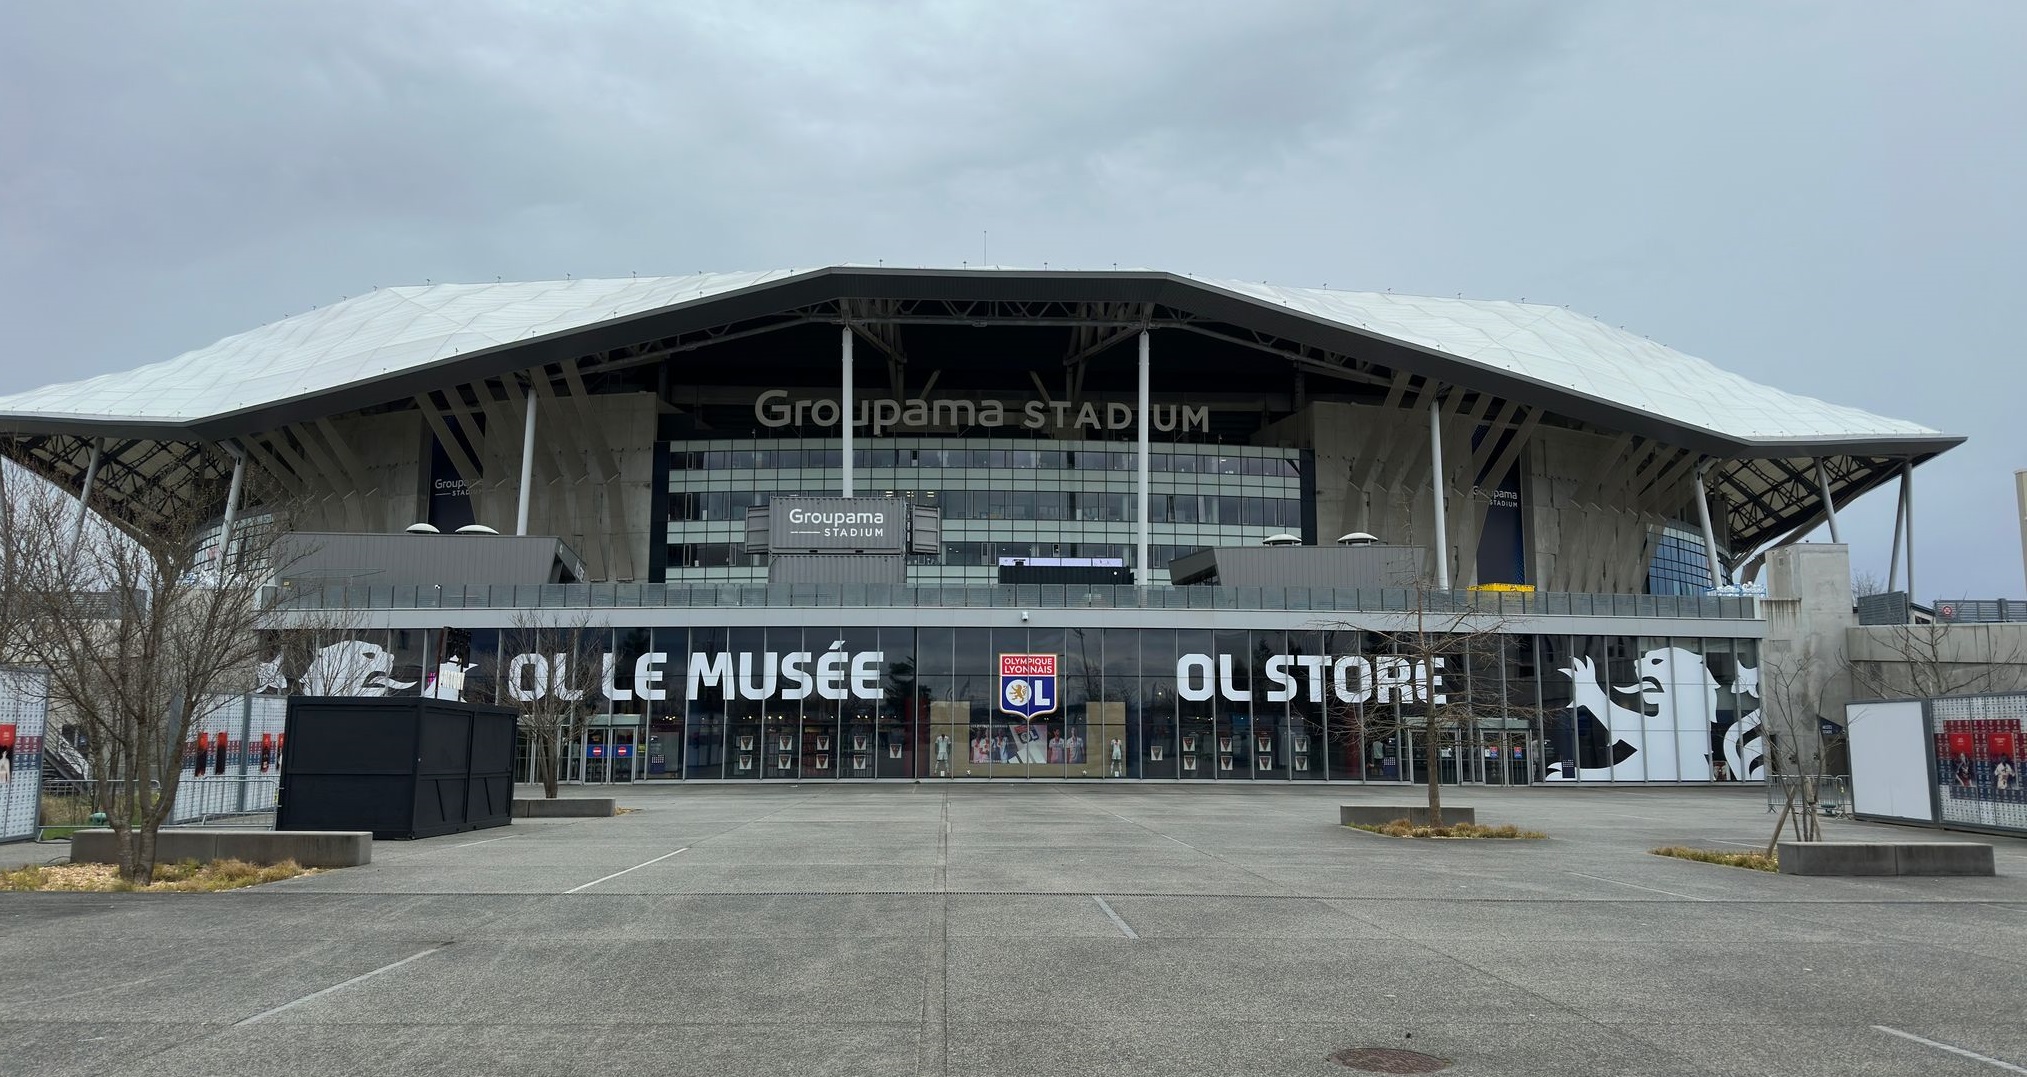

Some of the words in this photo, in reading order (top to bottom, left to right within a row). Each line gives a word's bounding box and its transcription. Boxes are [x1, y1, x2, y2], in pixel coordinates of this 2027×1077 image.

[754, 389, 1004, 436] Groupama
[1023, 400, 1209, 433] STADUM
[1473, 485, 1518, 499] Gpama
[789, 509, 885, 527] Groupama
[824, 528, 884, 537] STADIUM
[1004, 657, 1052, 665] OLYMPIQUE
[1004, 665, 1052, 673] LYONNAIS
[508, 652, 584, 701] OL
[601, 652, 668, 701] LE
[686, 640, 884, 701] MUSÉE
[1177, 653, 1250, 702] OL
[1266, 654, 1447, 704] STORE
[1005, 679, 1050, 706] OL
